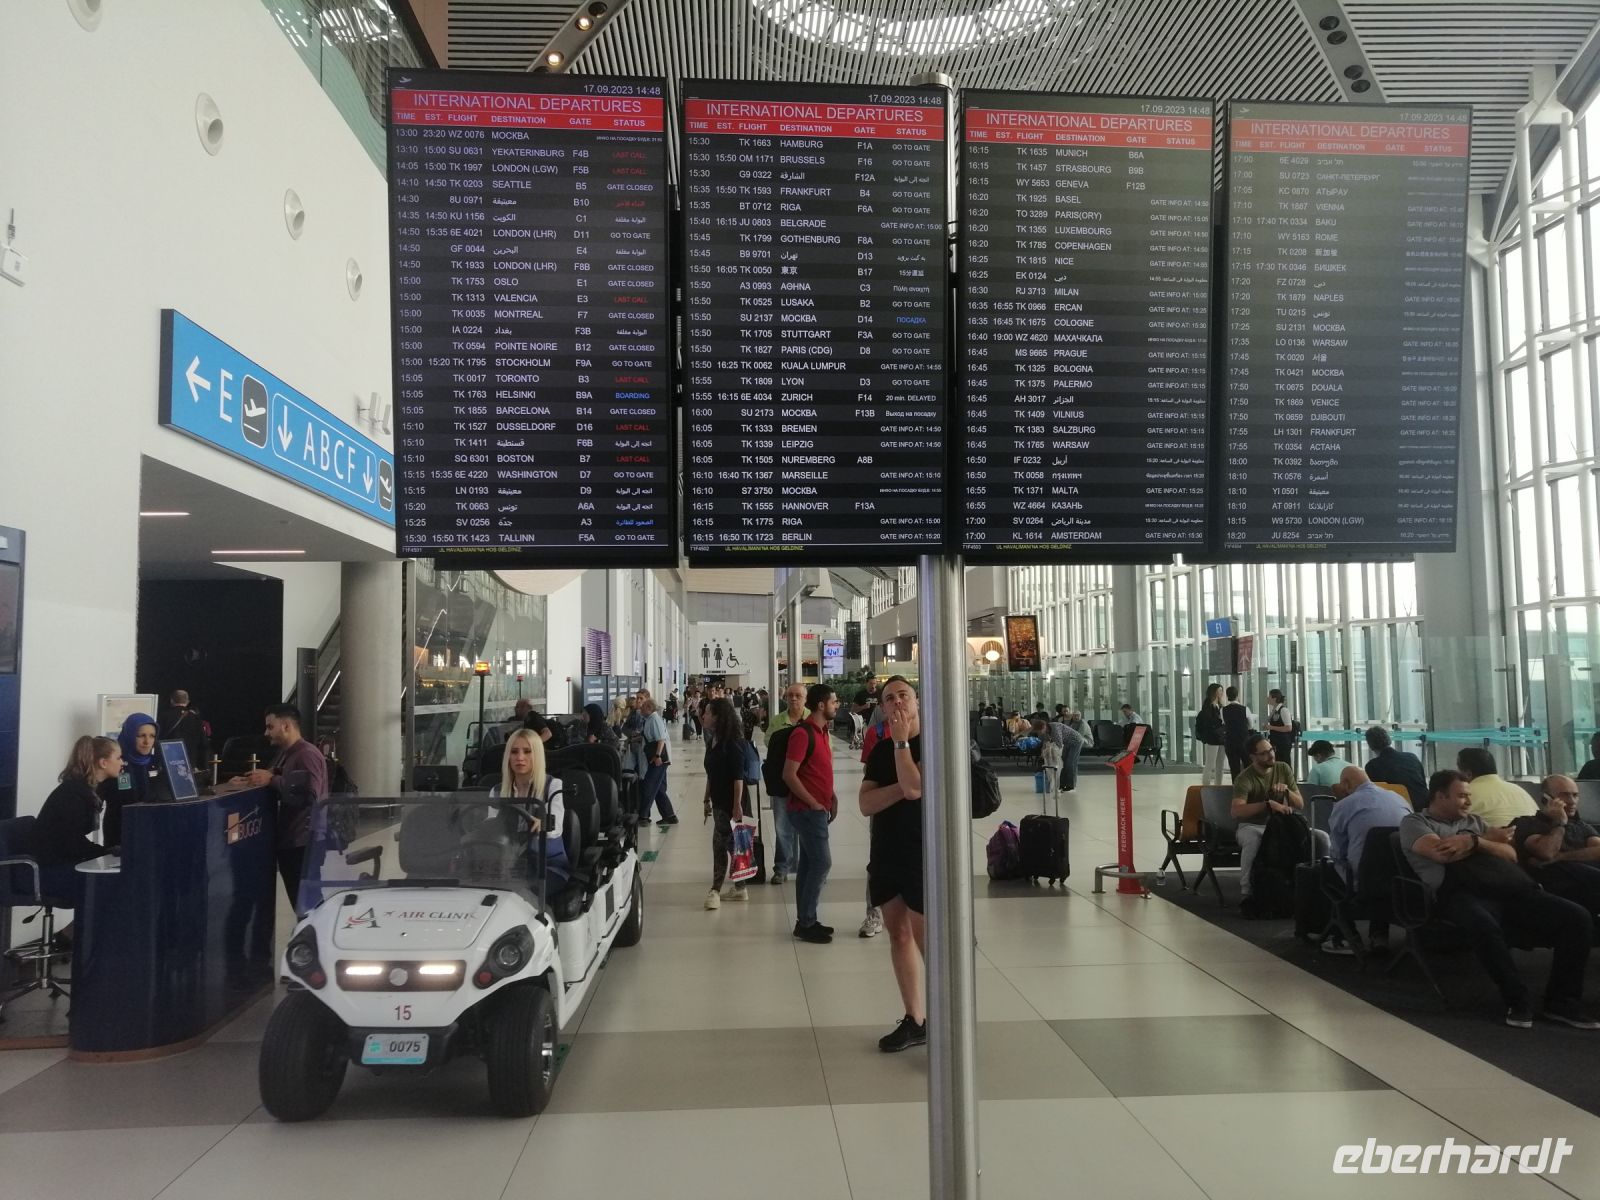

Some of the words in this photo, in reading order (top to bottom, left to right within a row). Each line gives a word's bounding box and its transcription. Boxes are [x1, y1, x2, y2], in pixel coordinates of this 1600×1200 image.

[583, 85, 633, 94] 17.09.2023
[636, 87, 660, 95] 14:48
[414, 94, 534, 109] INTERNATIONAL
[540, 99, 641, 112] DEPARTURES
[868, 95, 916, 104] 17.09.2023
[919, 96, 941, 104] 14:48
[706, 104, 822, 118] INTERNATIONAL
[826, 108, 923, 121] DEPARTURES
[1141, 105, 1185, 114] 17.09.2023
[1189, 107, 1210, 115] 14:48
[396, 112, 415, 120] TIME
[491, 116, 545, 124] DESTINATION
[986, 114, 1096, 128] INTERNATIONAL
[1100, 119, 1192, 131] DEPARTURES
[780, 124, 832, 133] DESTINATION
[1251, 124, 1355, 137] INTERNATIONAL
[1360, 126, 1450, 138] DEPARTURES
[423, 129, 445, 137] 23:20
[448, 130, 462, 138] WZ
[492, 131, 529, 140] МОСКВА
[1056, 134, 1105, 142] DESTINATION
[1056, 149, 1087, 157] MUNICH
[689, 153, 710, 161] 15:30
[780, 156, 825, 164] BRUSSELS
[397, 178, 419, 186] 14:10
[449, 179, 461, 187] TK
[463, 180, 483, 188] 0203
[492, 181, 531, 189] SEATTLE
[576, 182, 586, 190] B5
[426, 228, 448, 236] 15:35
[493, 229, 530, 237] LONDON
[533, 230, 556, 239] (LHR)
[690, 265, 711, 273] 15:50
[753, 266, 772, 274] 0050
[781, 266, 797, 275] 東京
[858, 268, 872, 276] B17
[219, 368, 233, 423] E
[402, 390, 423, 398] 15:05
[453, 390, 464, 398] TK
[576, 391, 592, 399] B9A
[781, 393, 812, 401] ZURICH
[1311, 428, 1356, 436] FRANKFURT
[303, 421, 355, 484] ABCF
[1308, 517, 1341, 525] LONDON
[1343, 517, 1364, 525] (LGW)
[456, 534, 468, 542] TK
[471, 534, 490, 542] 1423
[499, 534, 534, 542] TALLINN
[394, 1005, 412, 1021] 15
[389, 1040, 421, 1052] 0075
